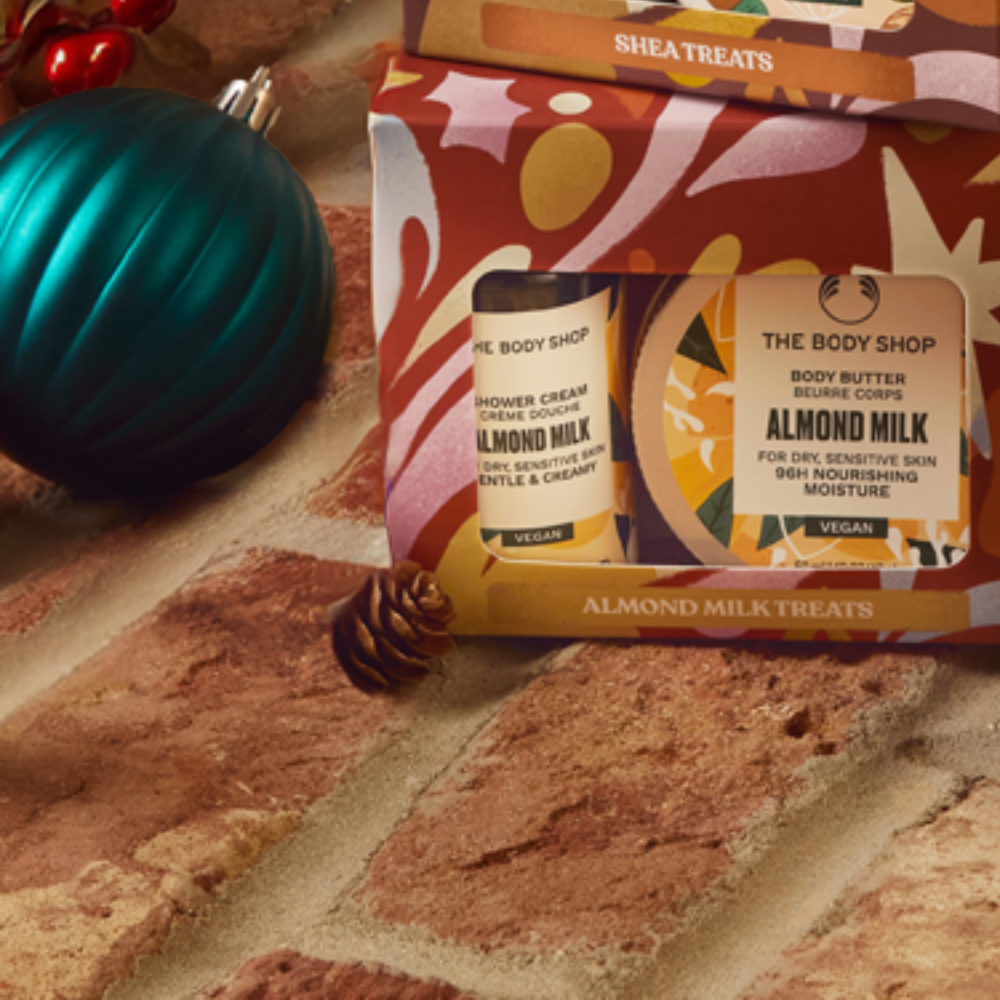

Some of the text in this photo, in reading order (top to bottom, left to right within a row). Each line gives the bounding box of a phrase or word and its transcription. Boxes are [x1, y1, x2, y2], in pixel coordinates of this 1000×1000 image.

[614, 33, 774, 73] SHEA TREATS
[472, 326, 590, 355] HE BODY SHOP
[762, 332, 937, 354] THE BODY SHOP
[791, 370, 906, 386] BODY BUTTER
[540, 383, 588, 405] CREAM
[794, 386, 903, 401] BEURRE CORPS
[529, 401, 580, 420] DOUCHE
[549, 416, 591, 449] MILK
[766, 407, 929, 445] ALMOND MILK
[514, 452, 579, 472] SENSITIVE
[581, 443, 606, 460] SKIN
[757, 450, 937, 468] FOR DRY, SENSITIVE SKIN
[479, 461, 597, 488] ENTLE & CREAMY
[775, 467, 918, 484] 96H NOURISHING
[804, 482, 891, 498] MOISTURE
[514, 529, 564, 543] VEGAN
[819, 520, 874, 534] VEGAN
[583, 596, 874, 619] ALMOND MILK TREATS
